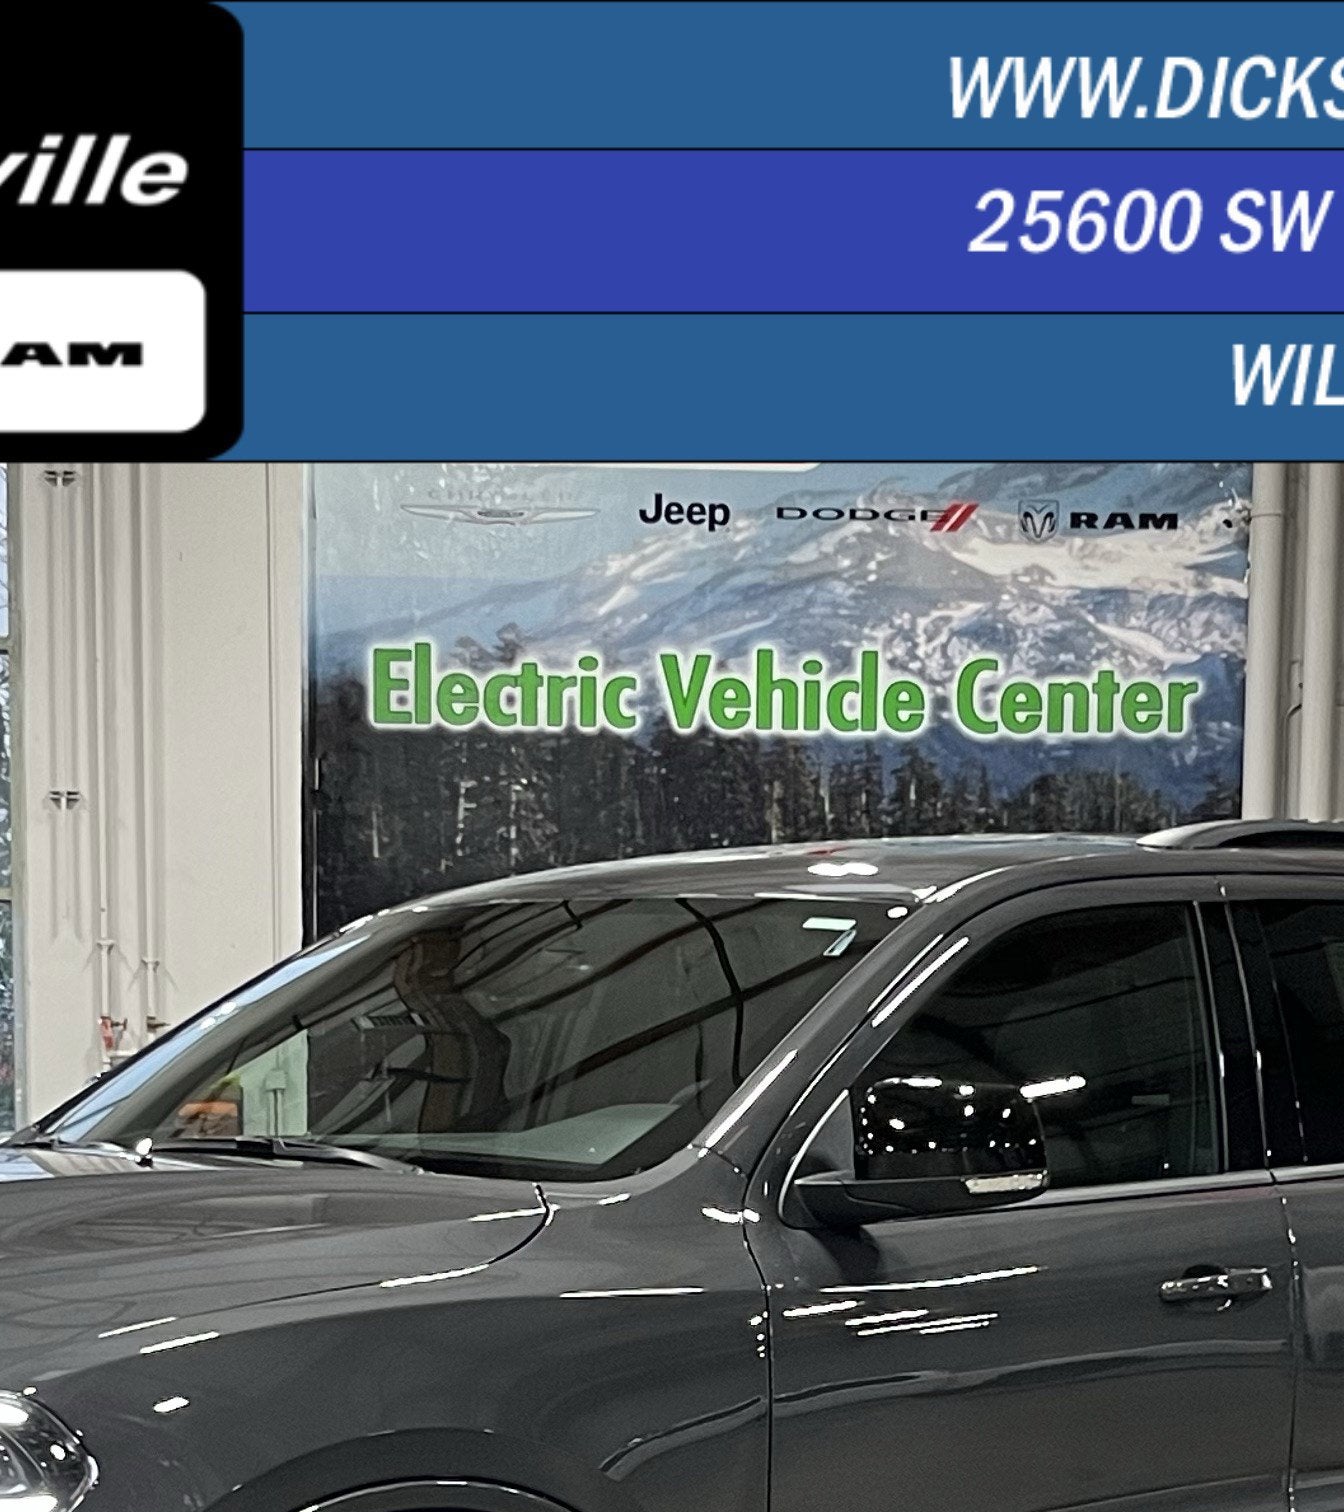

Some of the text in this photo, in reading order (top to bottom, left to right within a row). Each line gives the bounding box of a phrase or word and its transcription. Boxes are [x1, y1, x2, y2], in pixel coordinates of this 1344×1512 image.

[638, 493, 730, 532] Jeep
[776, 506, 948, 522] DODGE
[1069, 511, 1179, 531] RAM
[371, 642, 1200, 734] Electric Vehicle Center
